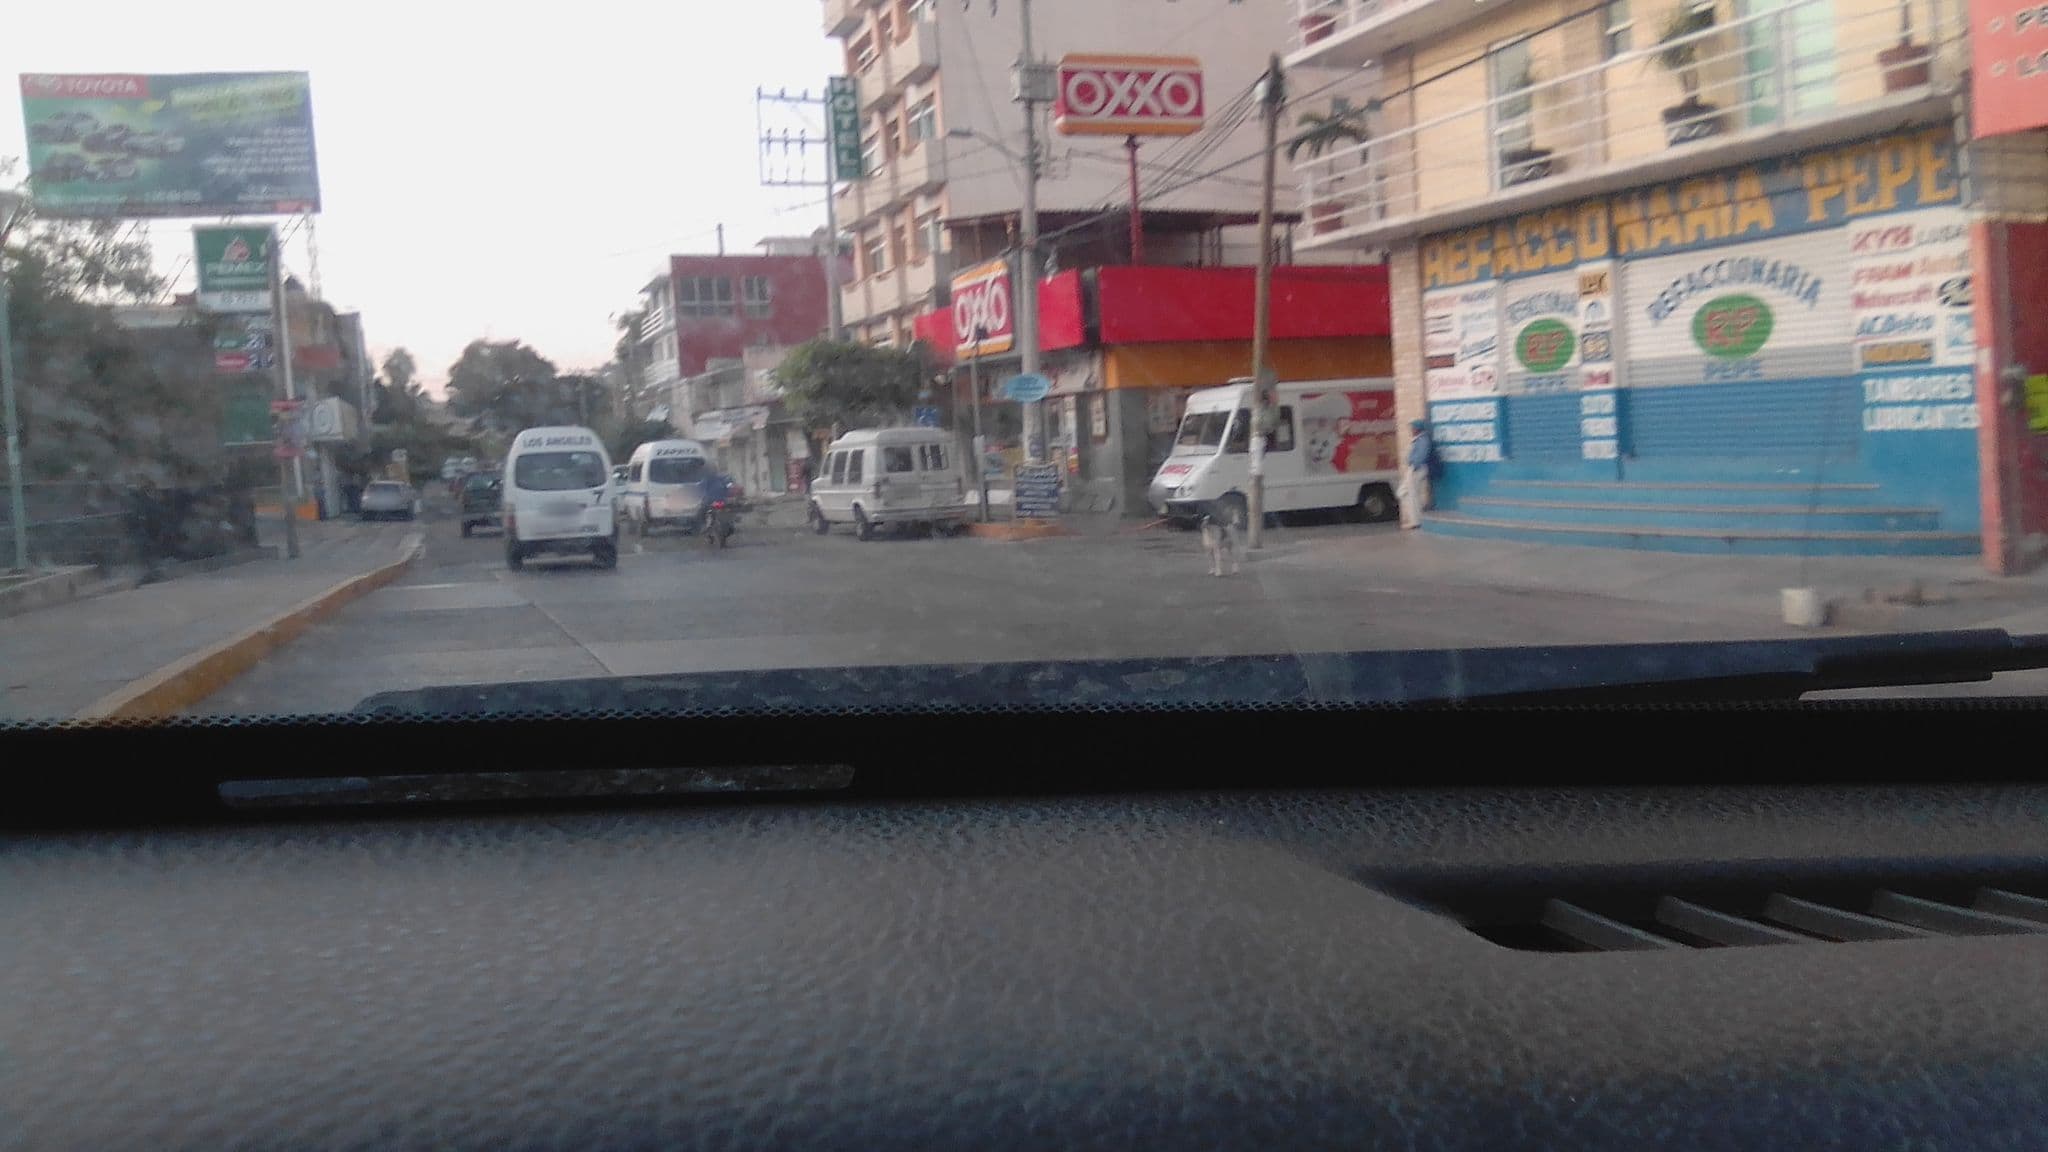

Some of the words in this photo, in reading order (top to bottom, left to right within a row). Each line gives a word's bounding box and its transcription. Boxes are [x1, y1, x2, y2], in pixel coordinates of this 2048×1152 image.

[66, 79, 138, 94] TOYOTA
[1065, 70, 1198, 118] OXXO
[831, 79, 860, 167] HOTEL
[1803, 128, 1958, 224] PEPE
[955, 278, 1008, 343] OXXO
[523, 436, 544, 448] LOS
[546, 435, 593, 446] ANGELES
[592, 490, 604, 504] 7
